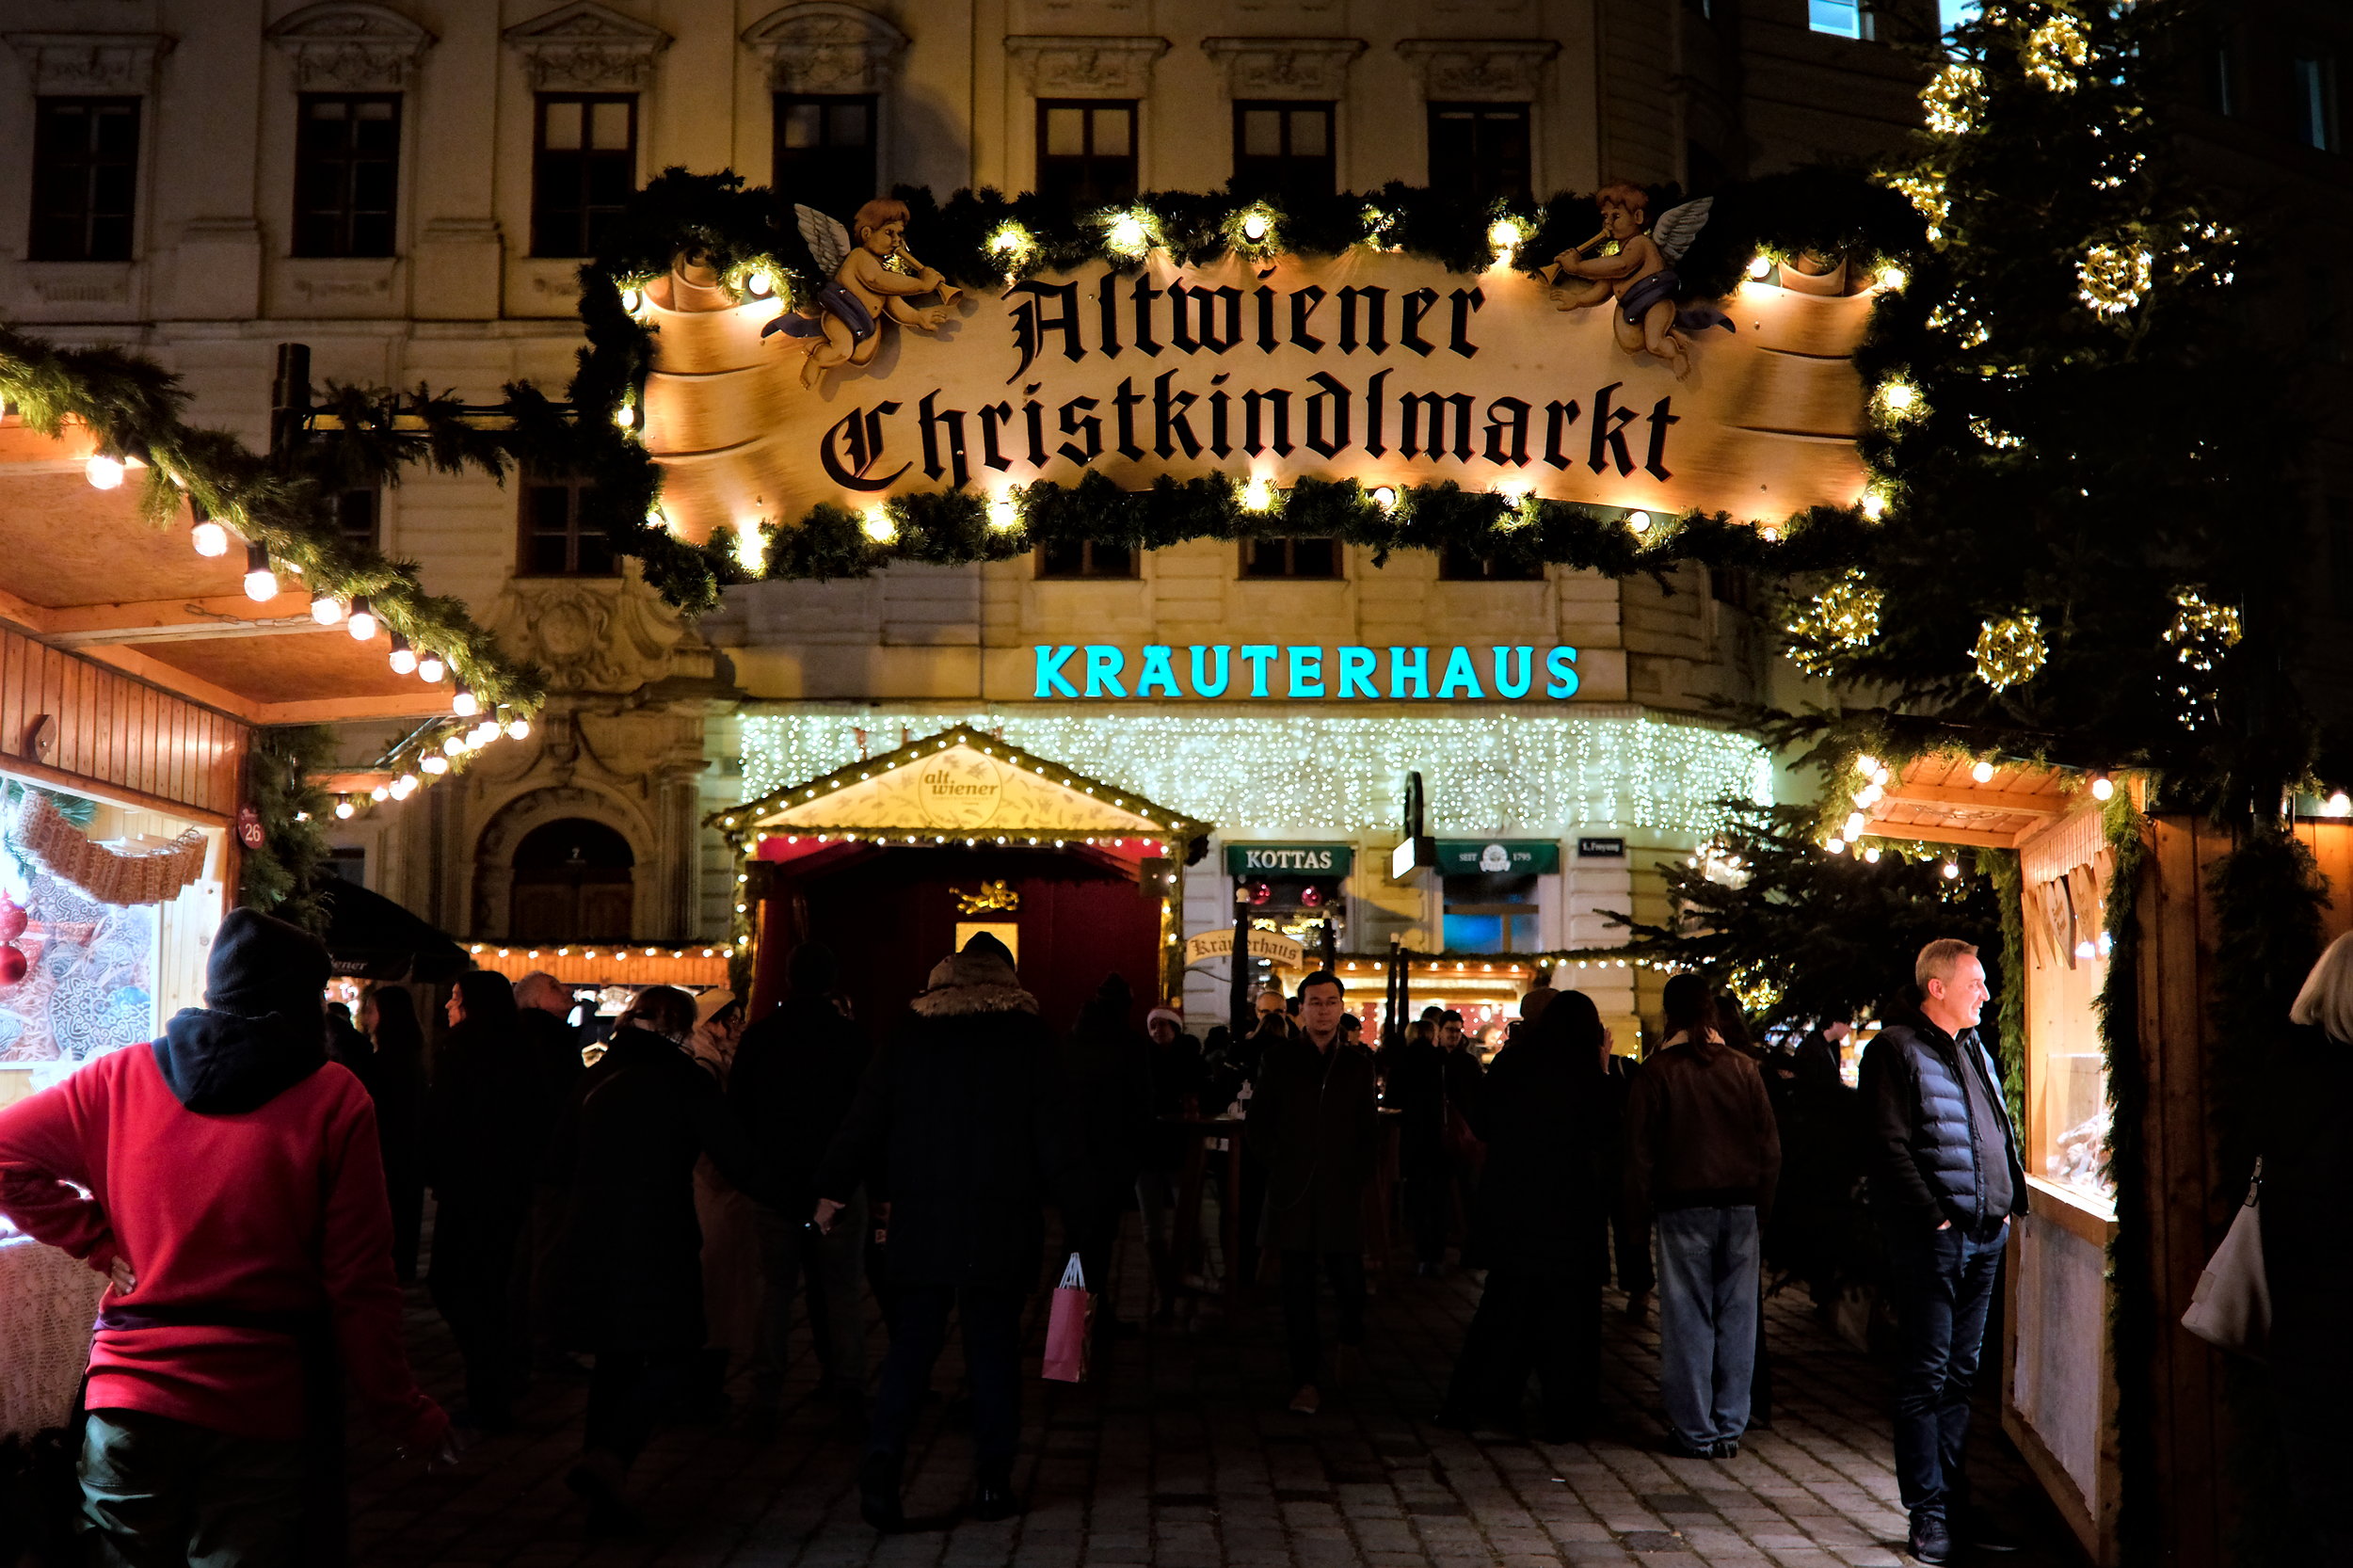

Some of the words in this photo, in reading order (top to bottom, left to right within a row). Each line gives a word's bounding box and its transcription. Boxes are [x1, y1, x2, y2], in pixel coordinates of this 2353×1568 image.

[1000, 267, 1486, 386] Altwiener
[820, 367, 1682, 493] Christkindlmarkt
[1033, 644, 1580, 699] KRÄUTERHAUS
[932, 780, 999, 796] wiener
[245, 823, 261, 842] 26
[1245, 849, 1333, 870] KOTTAS
